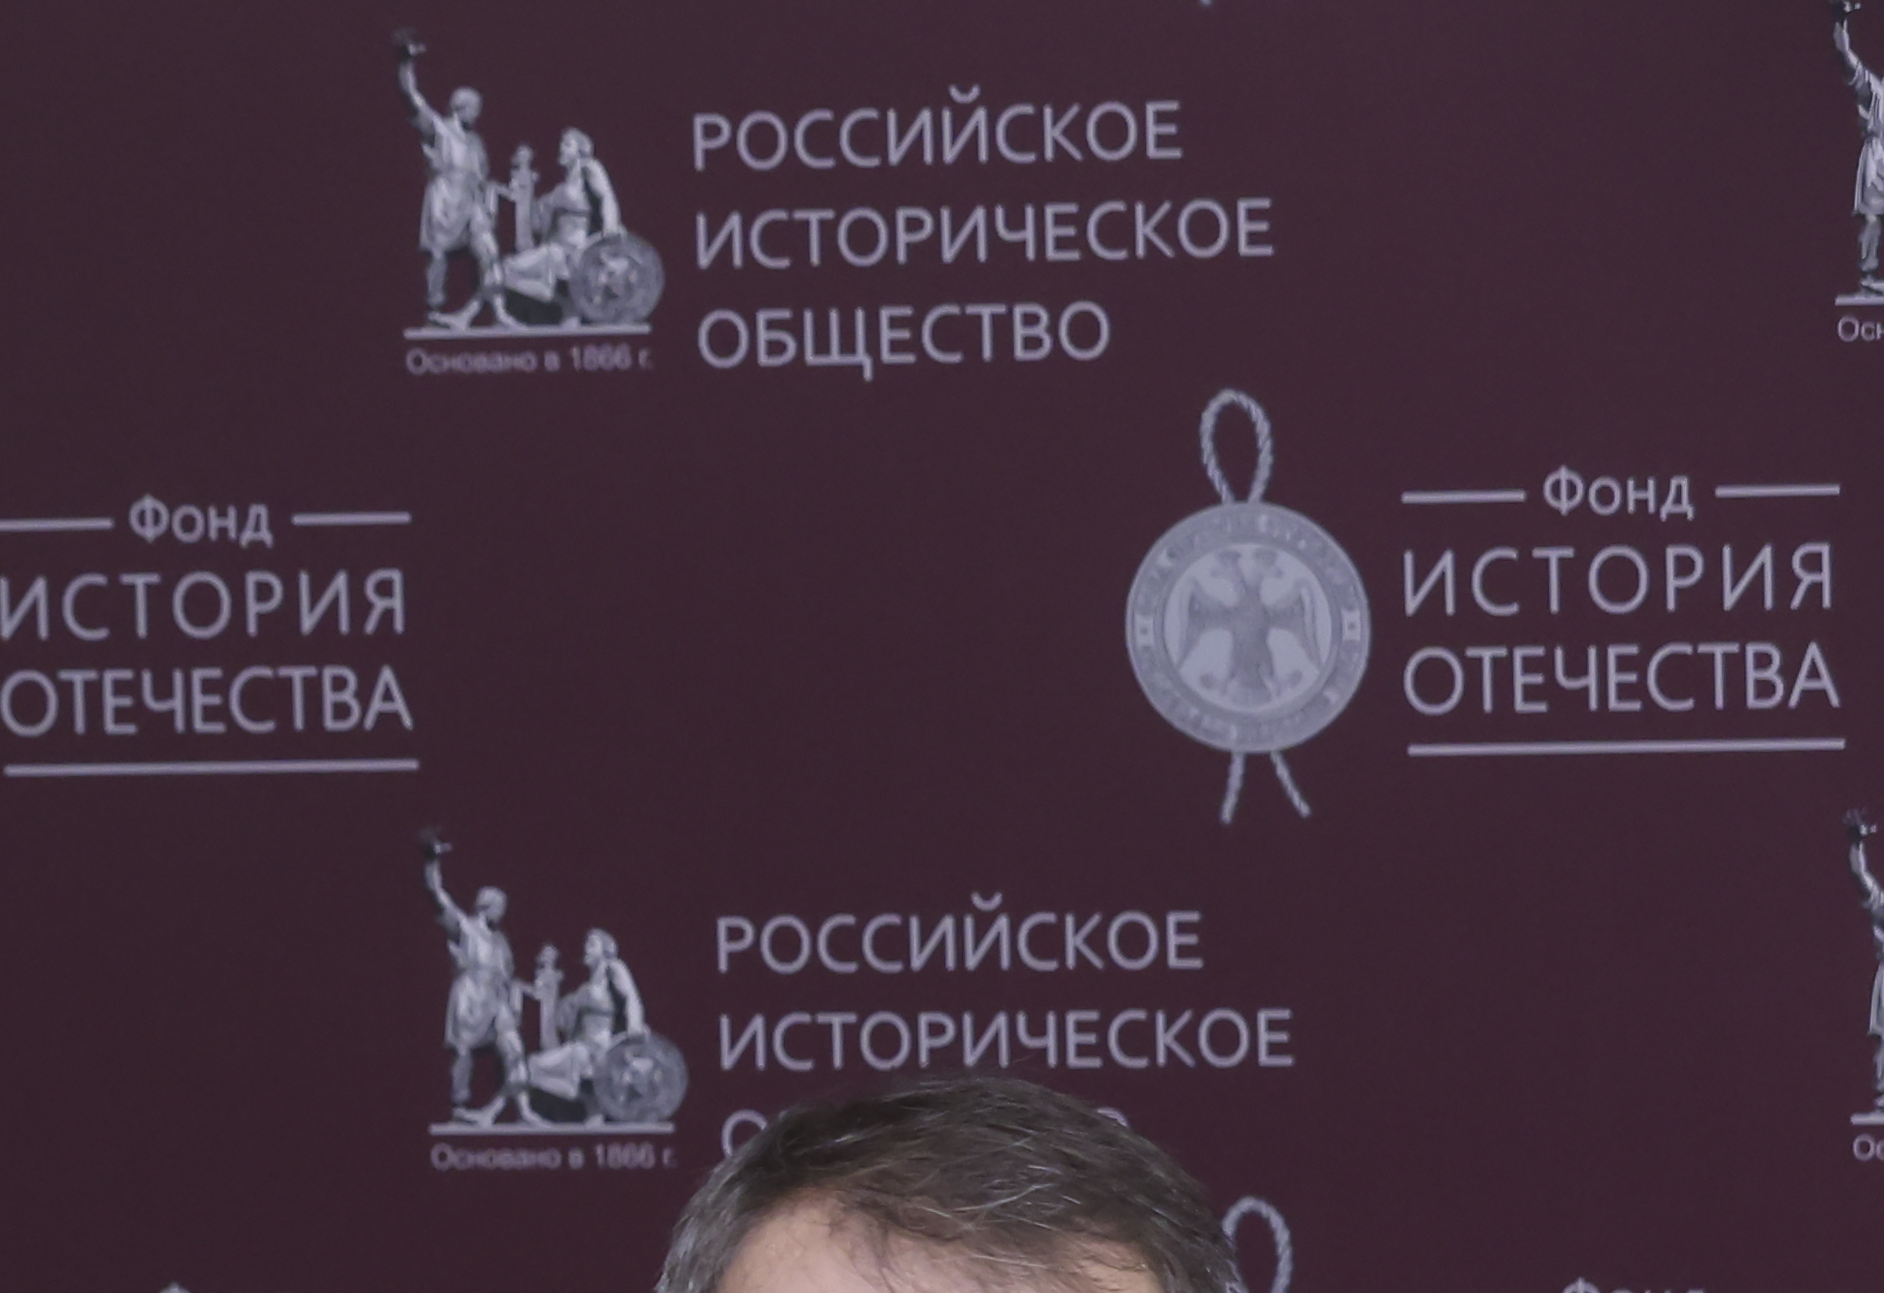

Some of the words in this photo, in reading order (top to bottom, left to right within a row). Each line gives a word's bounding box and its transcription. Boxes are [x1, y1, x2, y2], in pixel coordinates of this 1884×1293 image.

[693, 84, 1185, 173] РОССИЙСКОЕ
[696, 198, 1276, 271] ИСТОРИЧЕСКОЕ
[698, 301, 1112, 384] ОБЩЕСТВО
[129, 494, 275, 550] Фонд
[1543, 465, 1696, 524] Фонд
[1403, 542, 1833, 618] ИСТОРИЯ
[0, 665, 415, 739] ОТЕЧЕСТВА
[1403, 641, 1842, 717] ОТЕЧЕСТВА
[717, 892, 1206, 976] РОССИЙСКОЕ
[720, 1009, 1296, 1073] ИСТОРИЧЕСКОЕ
